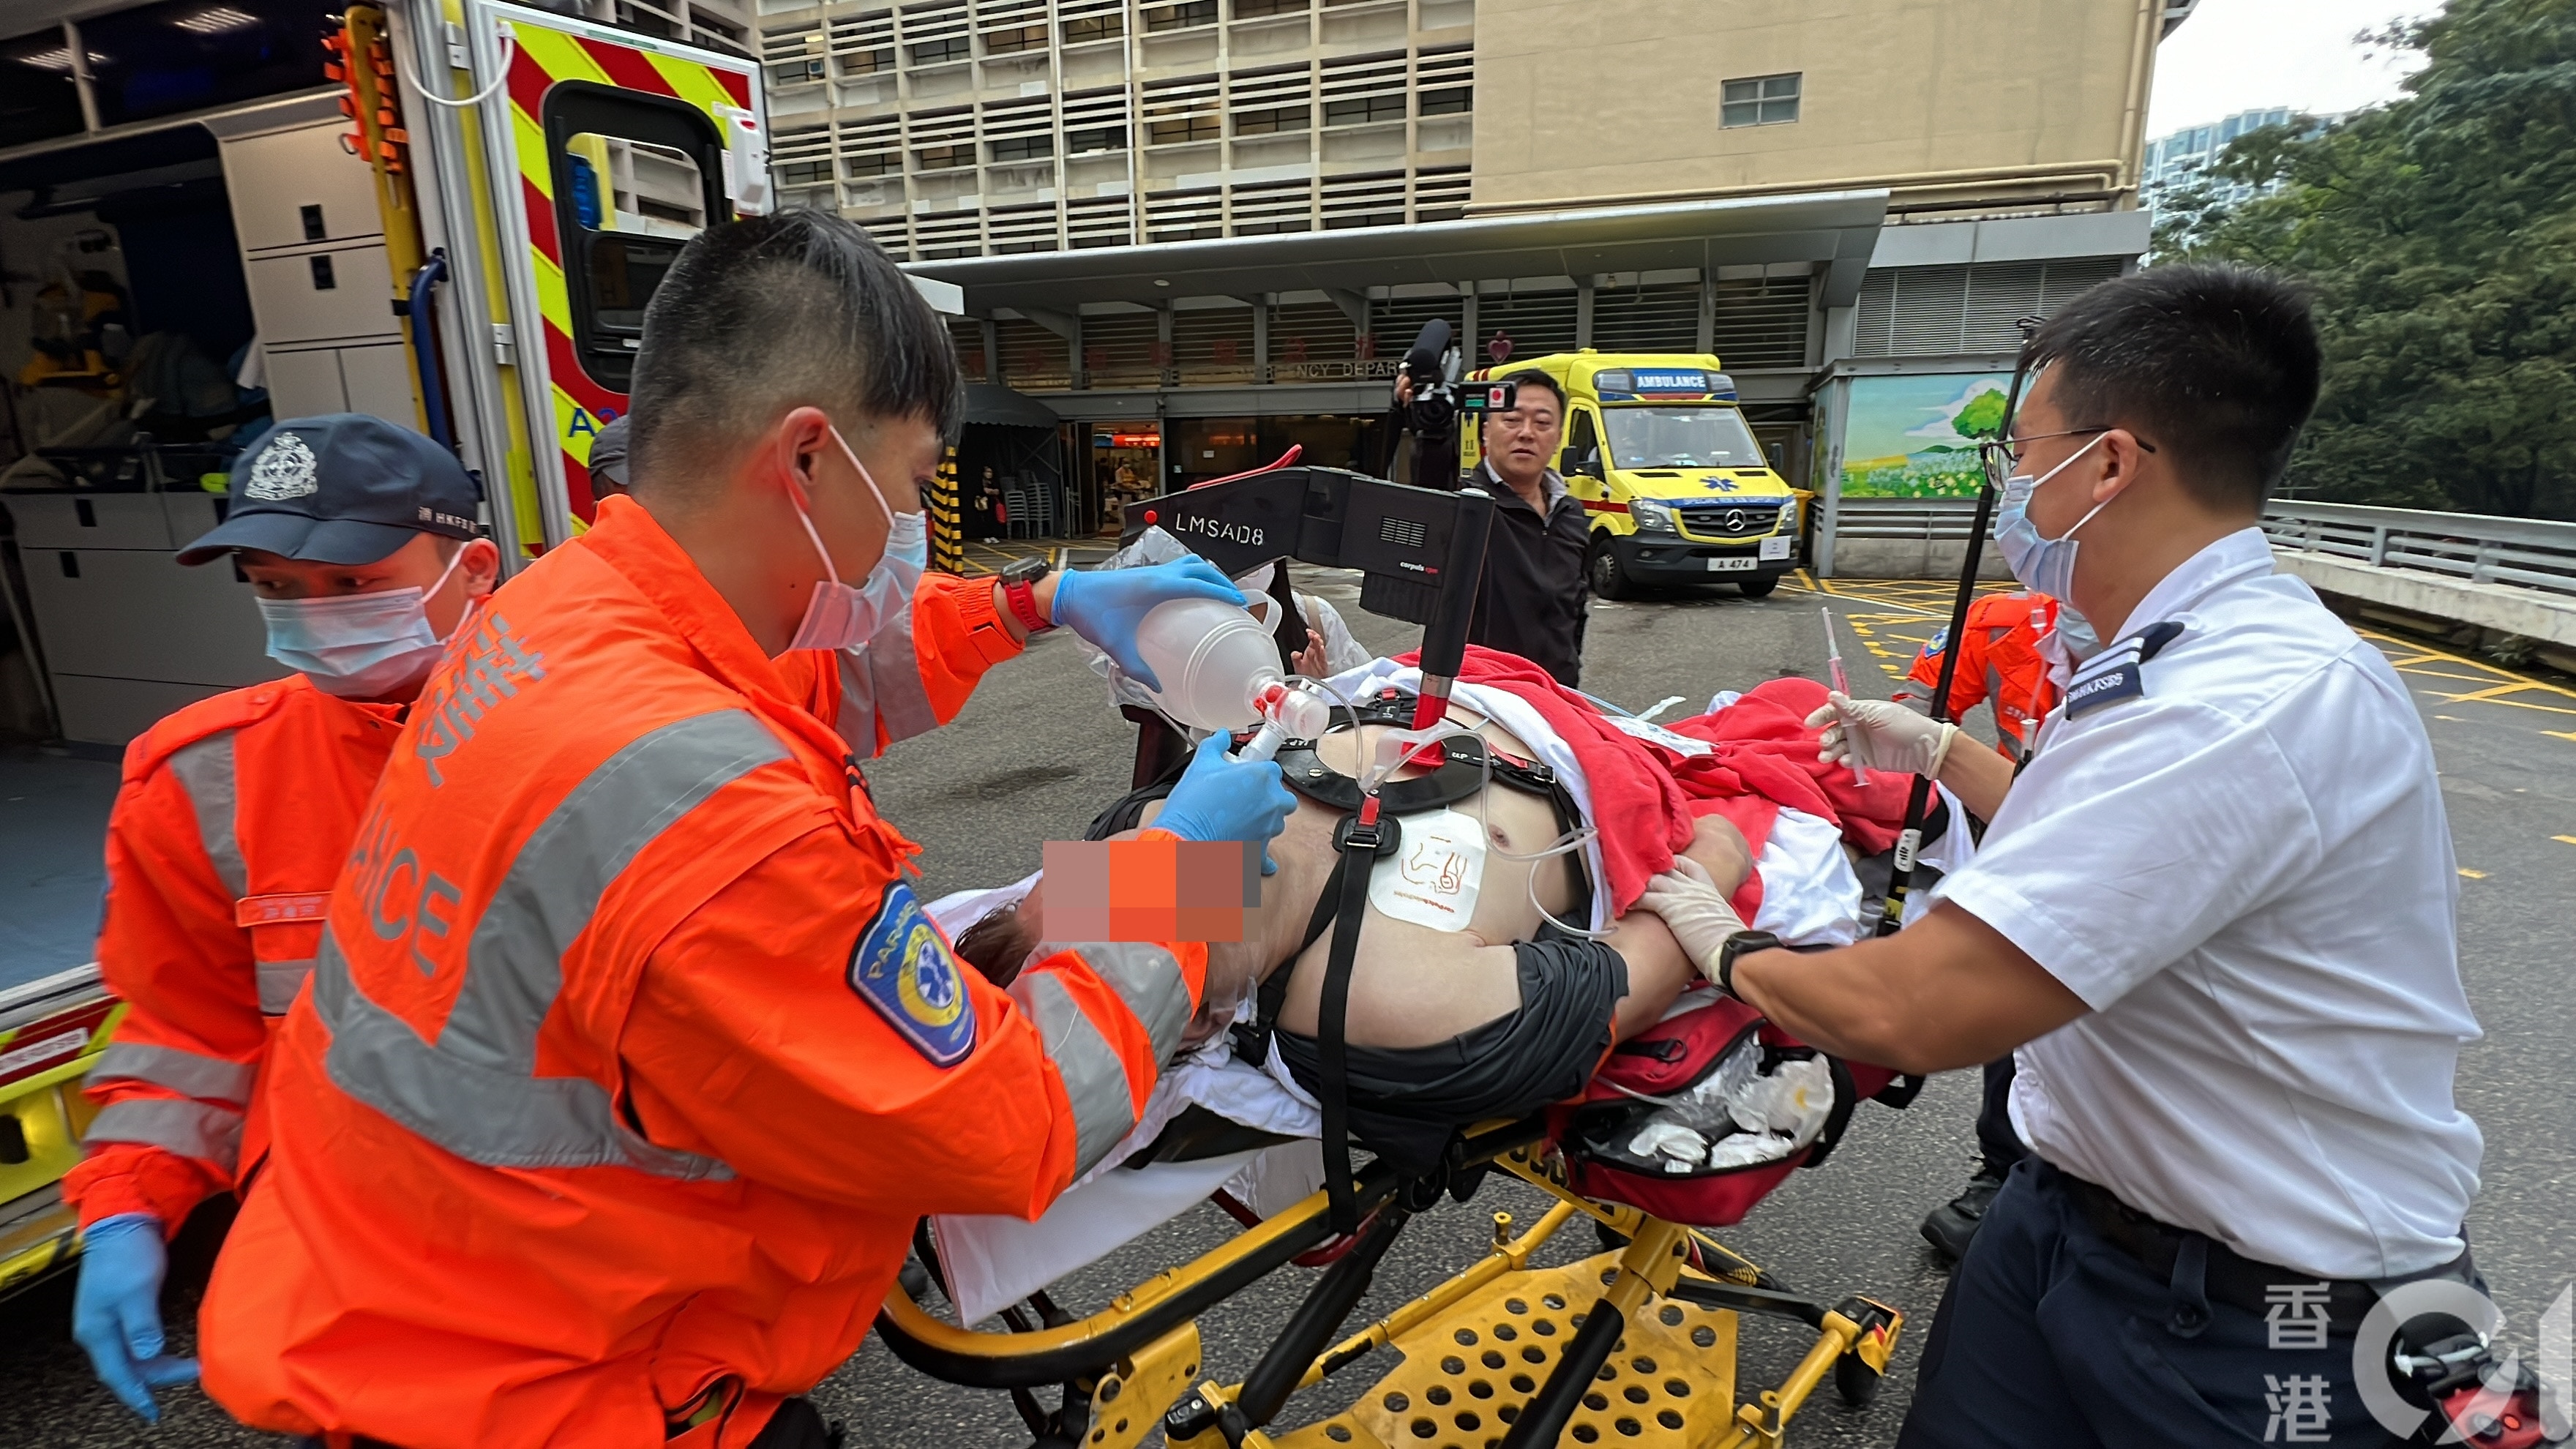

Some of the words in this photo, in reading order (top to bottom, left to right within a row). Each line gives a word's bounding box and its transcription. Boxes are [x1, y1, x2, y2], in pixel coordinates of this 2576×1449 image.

[1343, 361, 1401, 377] DEPAR
[1637, 375, 1706, 388] AMBULANCE
[1176, 513, 1264, 546] LMSAD8
[1718, 561, 1725, 569] A
[1729, 560, 1749, 568] 474
